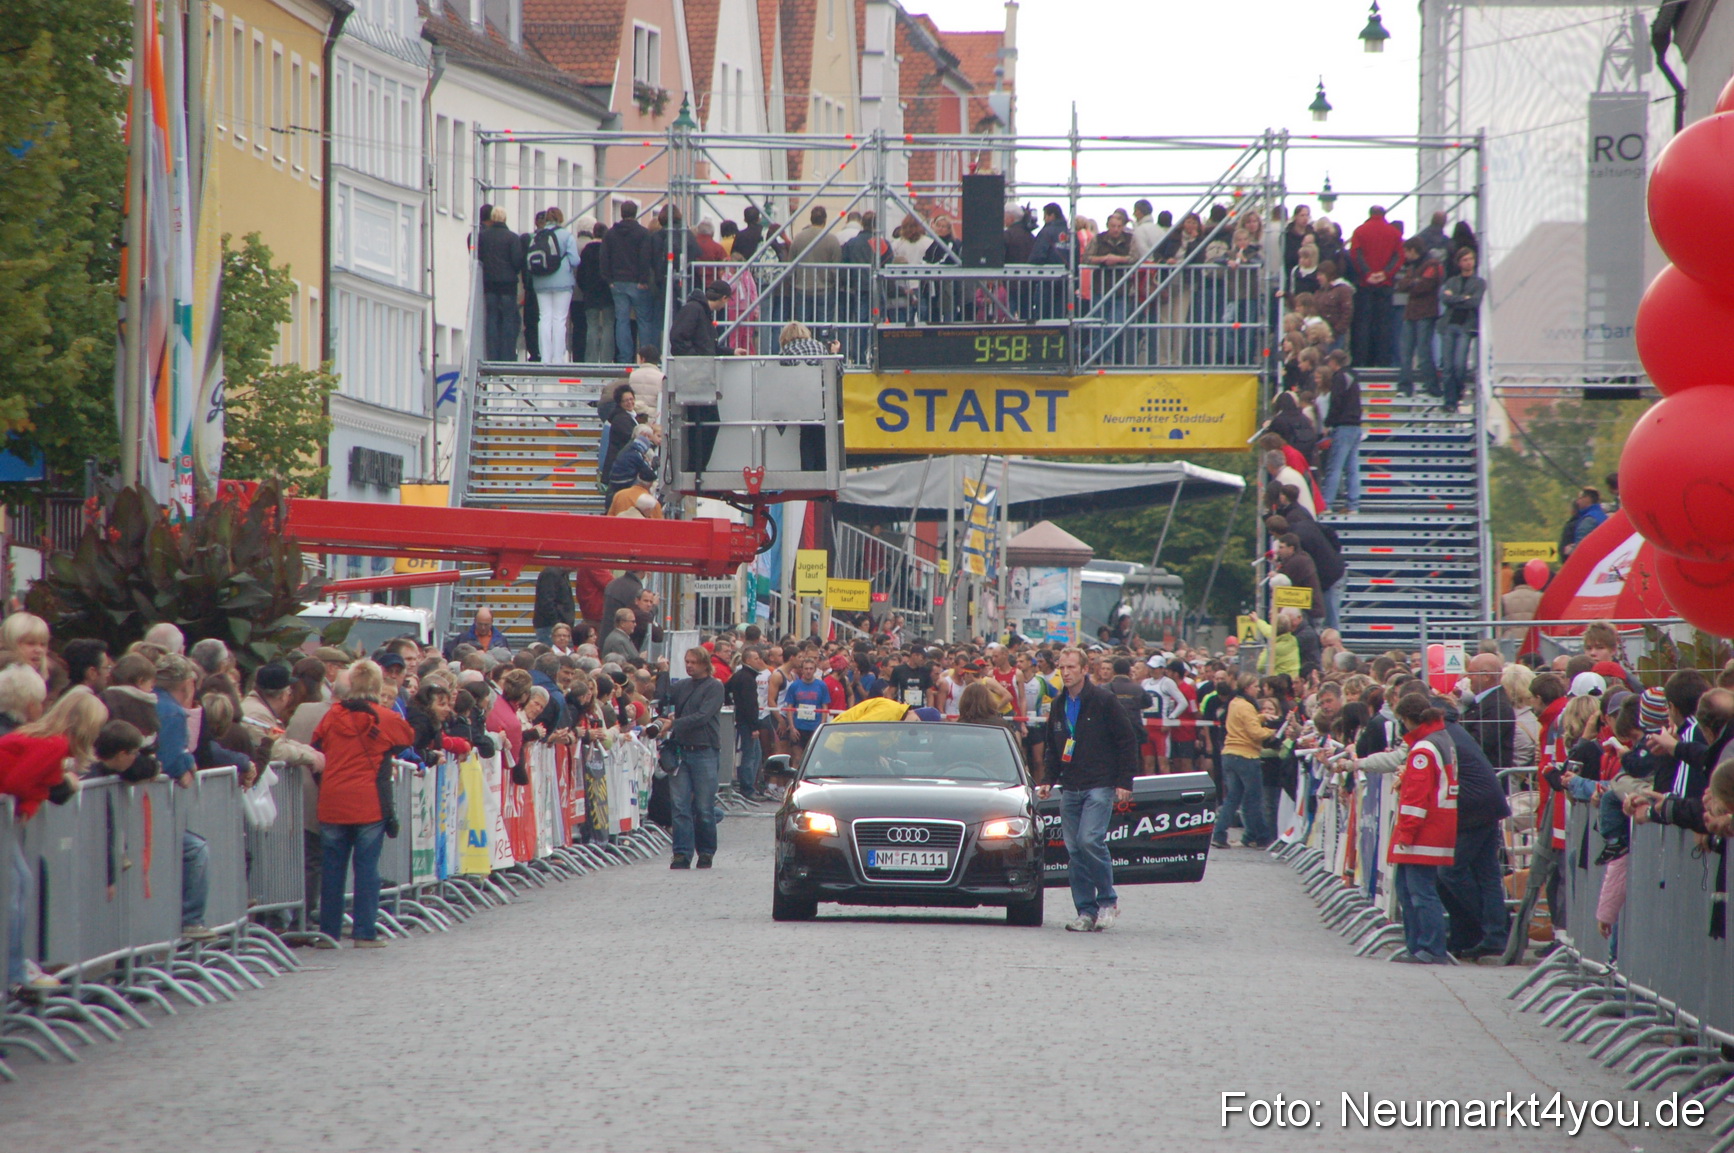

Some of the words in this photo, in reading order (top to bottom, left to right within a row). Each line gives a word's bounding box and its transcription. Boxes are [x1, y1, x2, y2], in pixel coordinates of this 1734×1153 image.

[875, 387, 1070, 432] START
[1103, 414, 1170, 424] Neumarkter
[1172, 412, 1226, 424] Stadtlauf
[798, 562, 827, 571] Jugend-
[805, 571, 819, 579] lauf
[828, 586, 868, 596] Schnupper-
[1104, 825, 1129, 842] udi
[1133, 813, 1171, 837] A3
[1175, 808, 1216, 829] Cab
[876, 852, 893, 865] NM
[1043, 862, 1068, 871] ische
[1112, 858, 1130, 866] bile
[1142, 854, 1188, 864] Neumarkt
